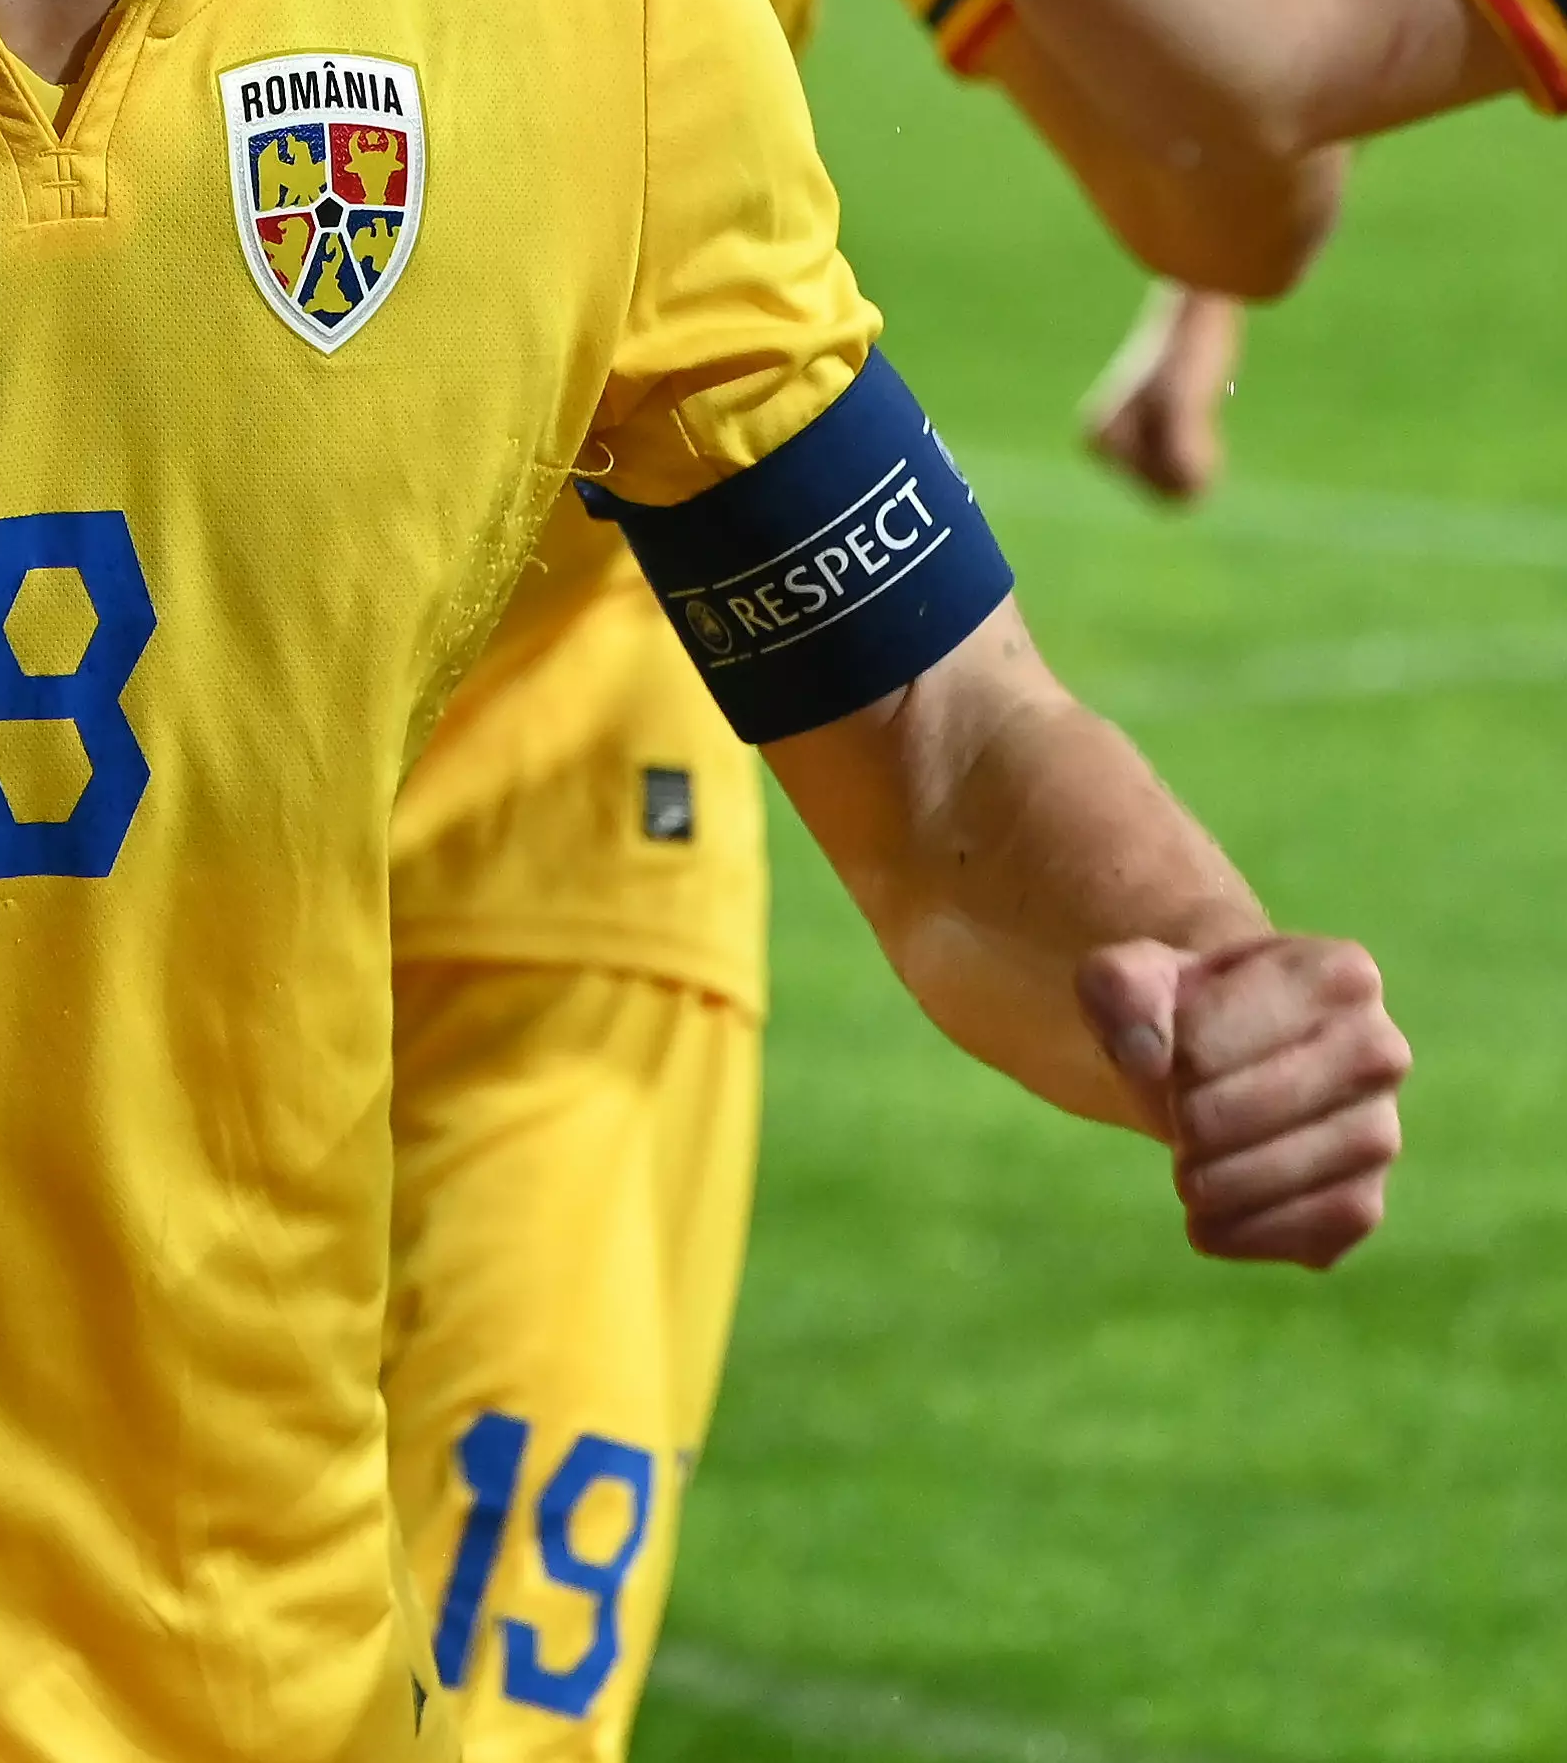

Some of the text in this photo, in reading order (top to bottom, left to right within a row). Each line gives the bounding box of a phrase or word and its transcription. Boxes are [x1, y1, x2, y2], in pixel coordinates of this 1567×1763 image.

[241, 61, 404, 122] ROMÂNIA
[727, 476, 933, 638] RESPECT
[434, 1410, 653, 1719] 19
